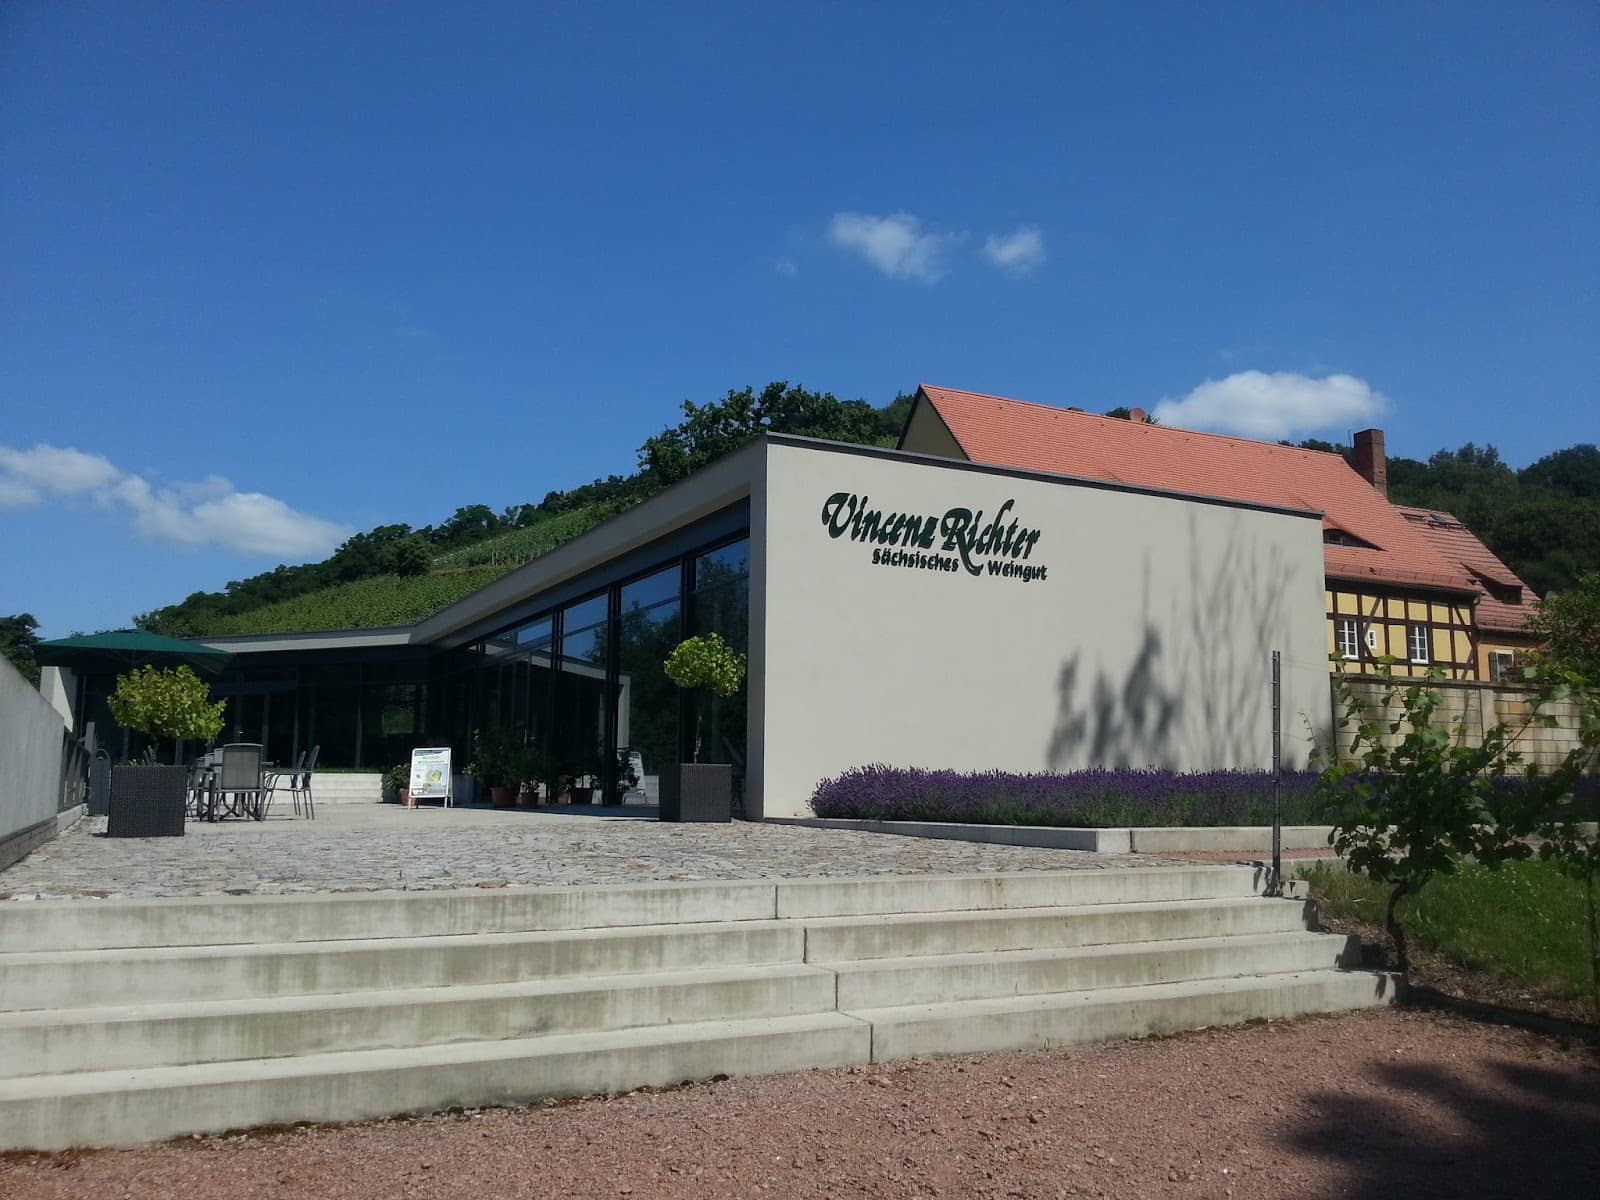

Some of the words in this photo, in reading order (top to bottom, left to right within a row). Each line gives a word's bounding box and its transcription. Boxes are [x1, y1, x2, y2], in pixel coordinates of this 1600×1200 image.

[822, 492, 939, 549] Vincenz
[941, 499, 1041, 576] Richter
[872, 548, 959, 572] Sächsisches
[988, 559, 1047, 583] Weingut
